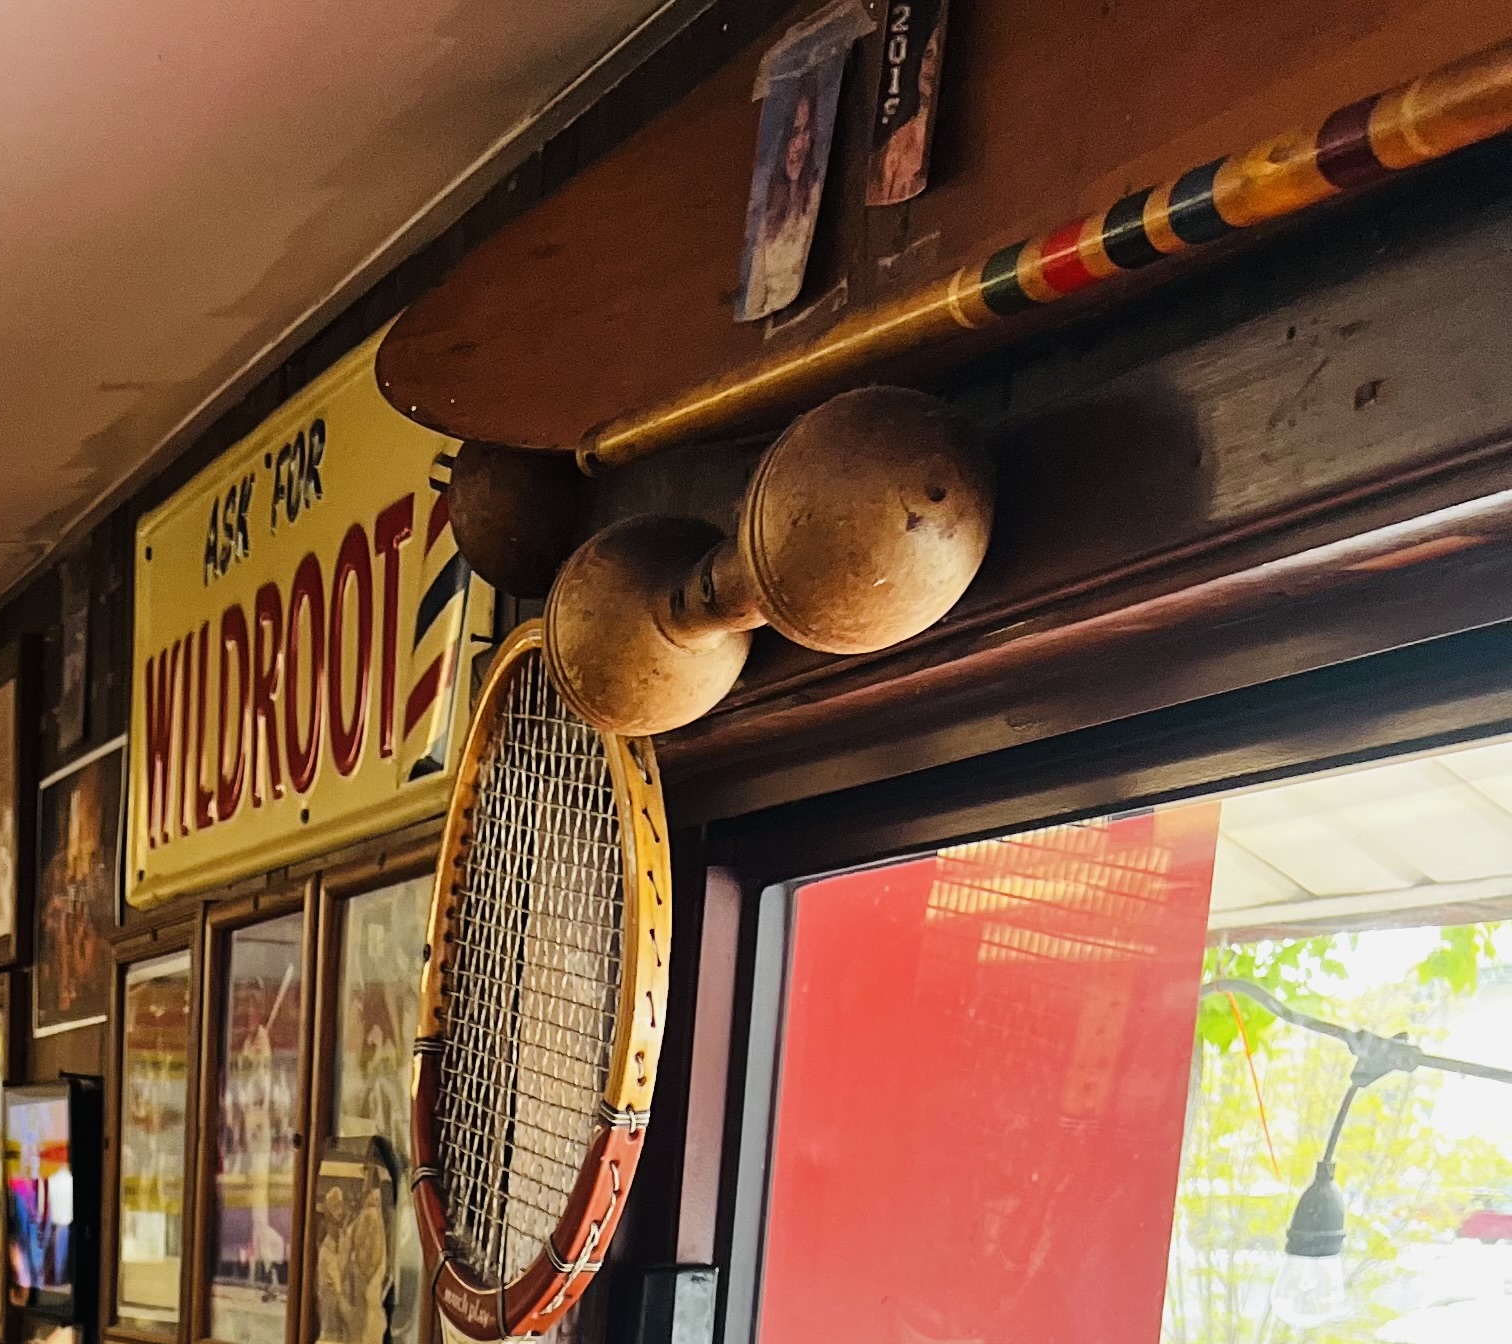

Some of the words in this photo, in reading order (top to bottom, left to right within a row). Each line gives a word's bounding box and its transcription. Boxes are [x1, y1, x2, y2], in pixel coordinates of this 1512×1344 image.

[202, 470, 256, 587] ASK
[268, 418, 328, 536] FOR
[144, 492, 416, 849] WILDROOT
